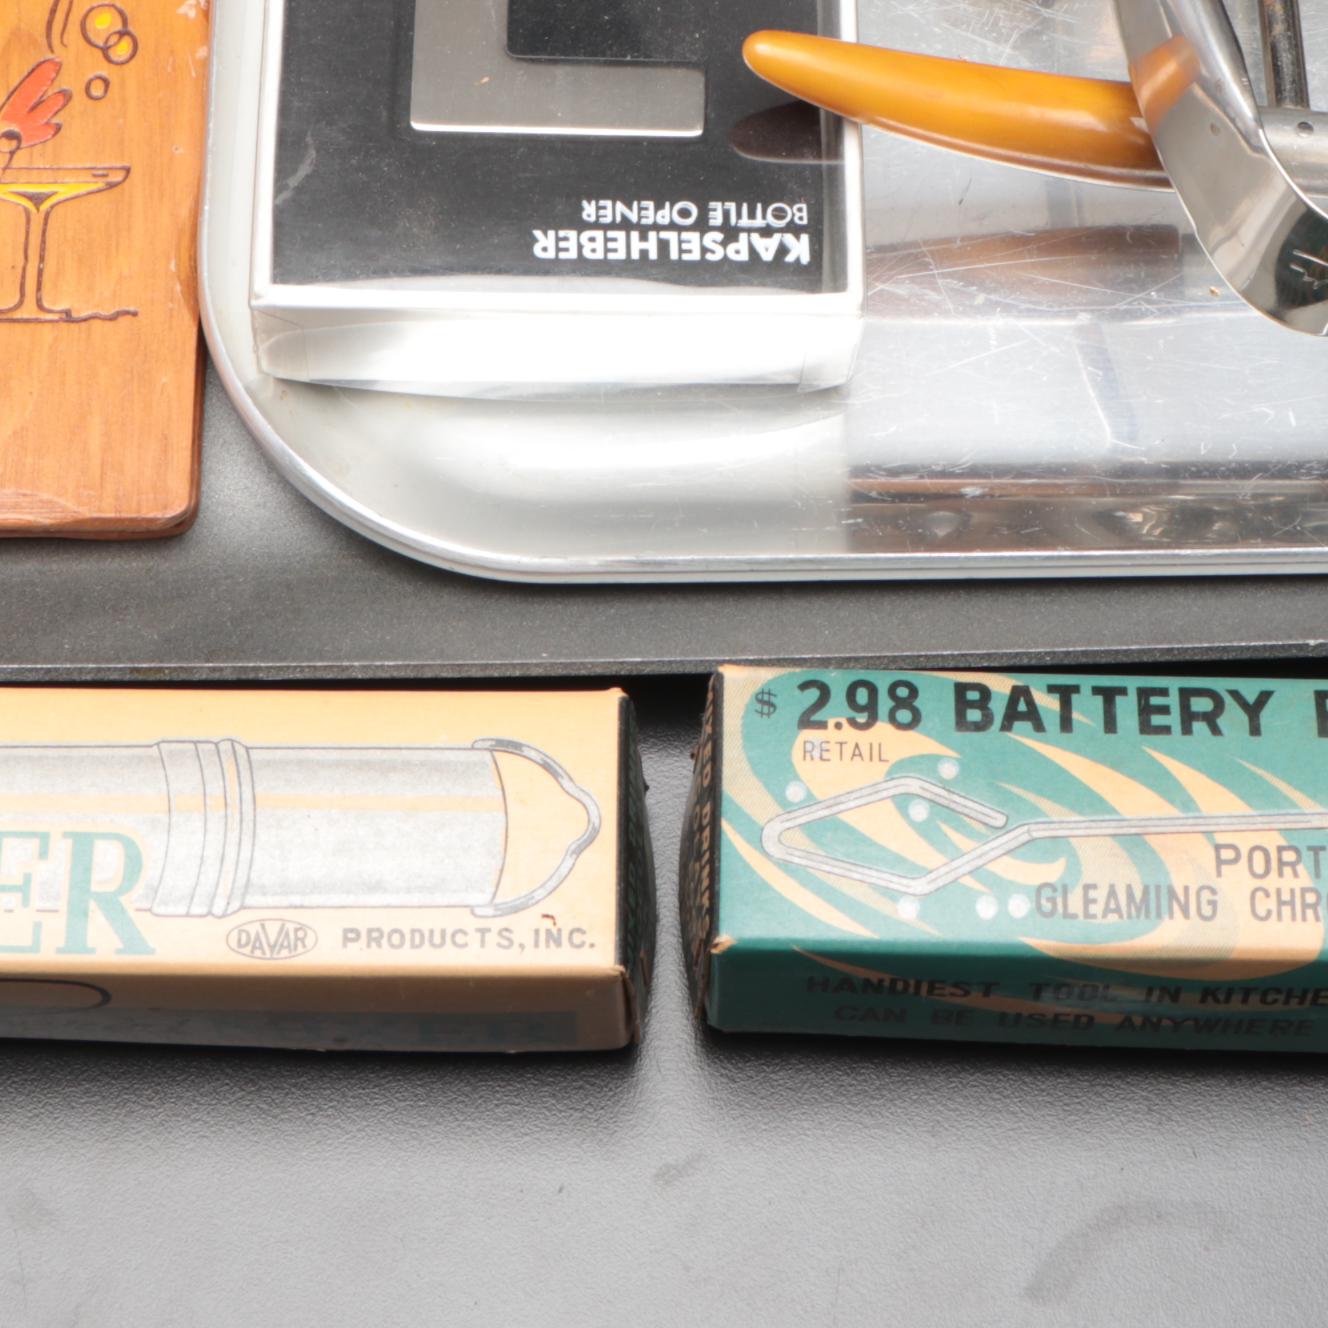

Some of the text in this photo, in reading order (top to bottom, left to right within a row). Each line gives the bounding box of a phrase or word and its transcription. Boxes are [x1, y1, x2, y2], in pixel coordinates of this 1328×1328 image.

[581, 200, 808, 226] BOTTLE OPENER
[532, 229, 810, 264] KAPSELHEBER
[953, 681, 1276, 739] BATTERY
[802, 738, 889, 764] RETAIL
[1035, 882, 1219, 923] GLEAMING
[236, 924, 310, 956] DAVAR
[807, 976, 1000, 1002] HANDIEST
[1030, 981, 1123, 1005] TOOL
[1143, 984, 1184, 1005] IN
[833, 1005, 920, 1026] CAN
[997, 1010, 1097, 1033] USED
[1115, 1013, 1315, 1038] ANYWHERE
